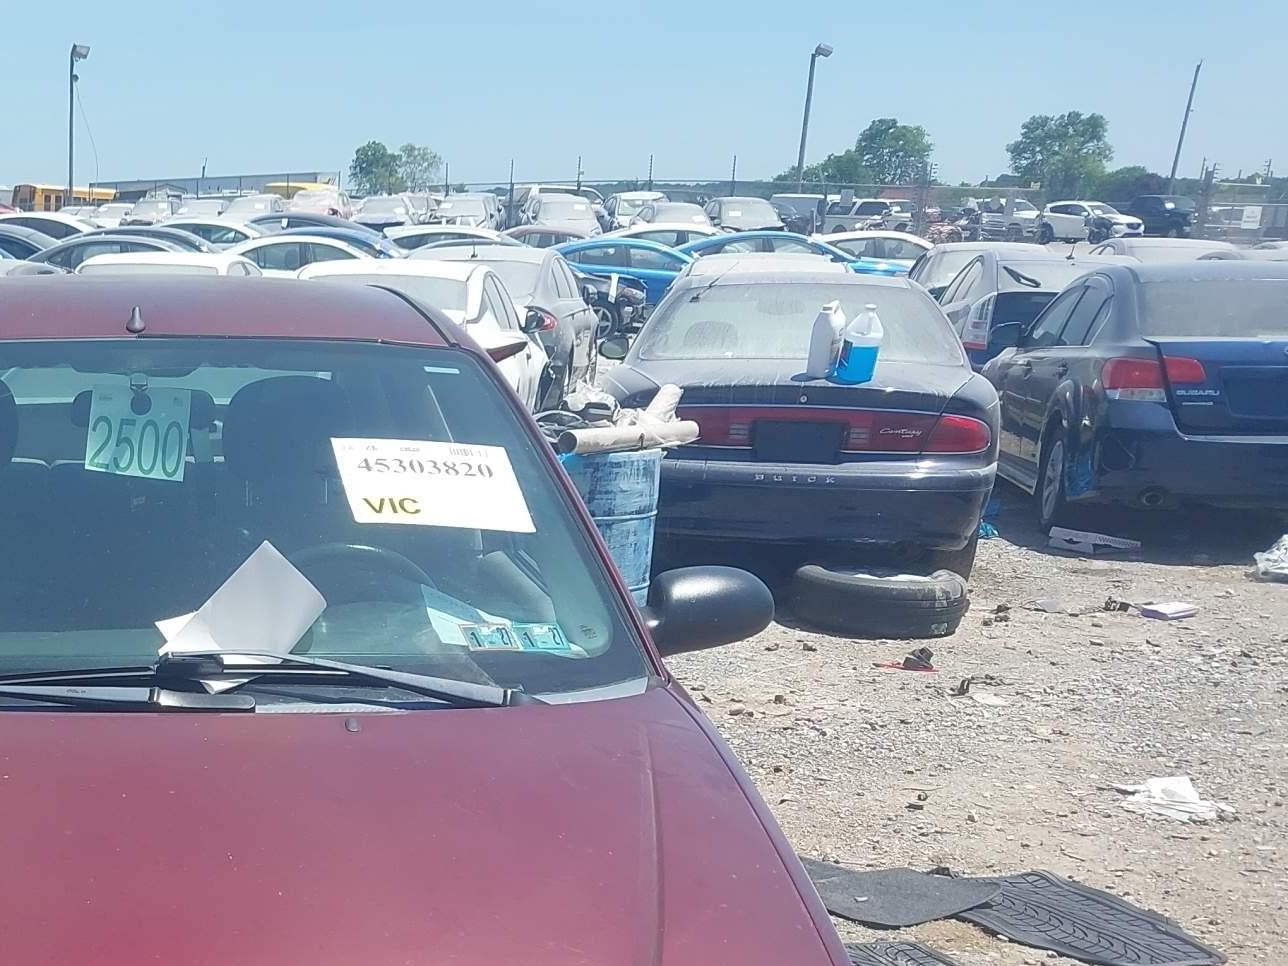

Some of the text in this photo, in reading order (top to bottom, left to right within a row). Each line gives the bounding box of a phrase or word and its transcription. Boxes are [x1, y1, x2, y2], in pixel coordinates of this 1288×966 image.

[87, 415, 184, 478] 2500
[357, 457, 494, 478] 45303820
[754, 473, 836, 484] BUICK
[362, 497, 422, 515] VIC
